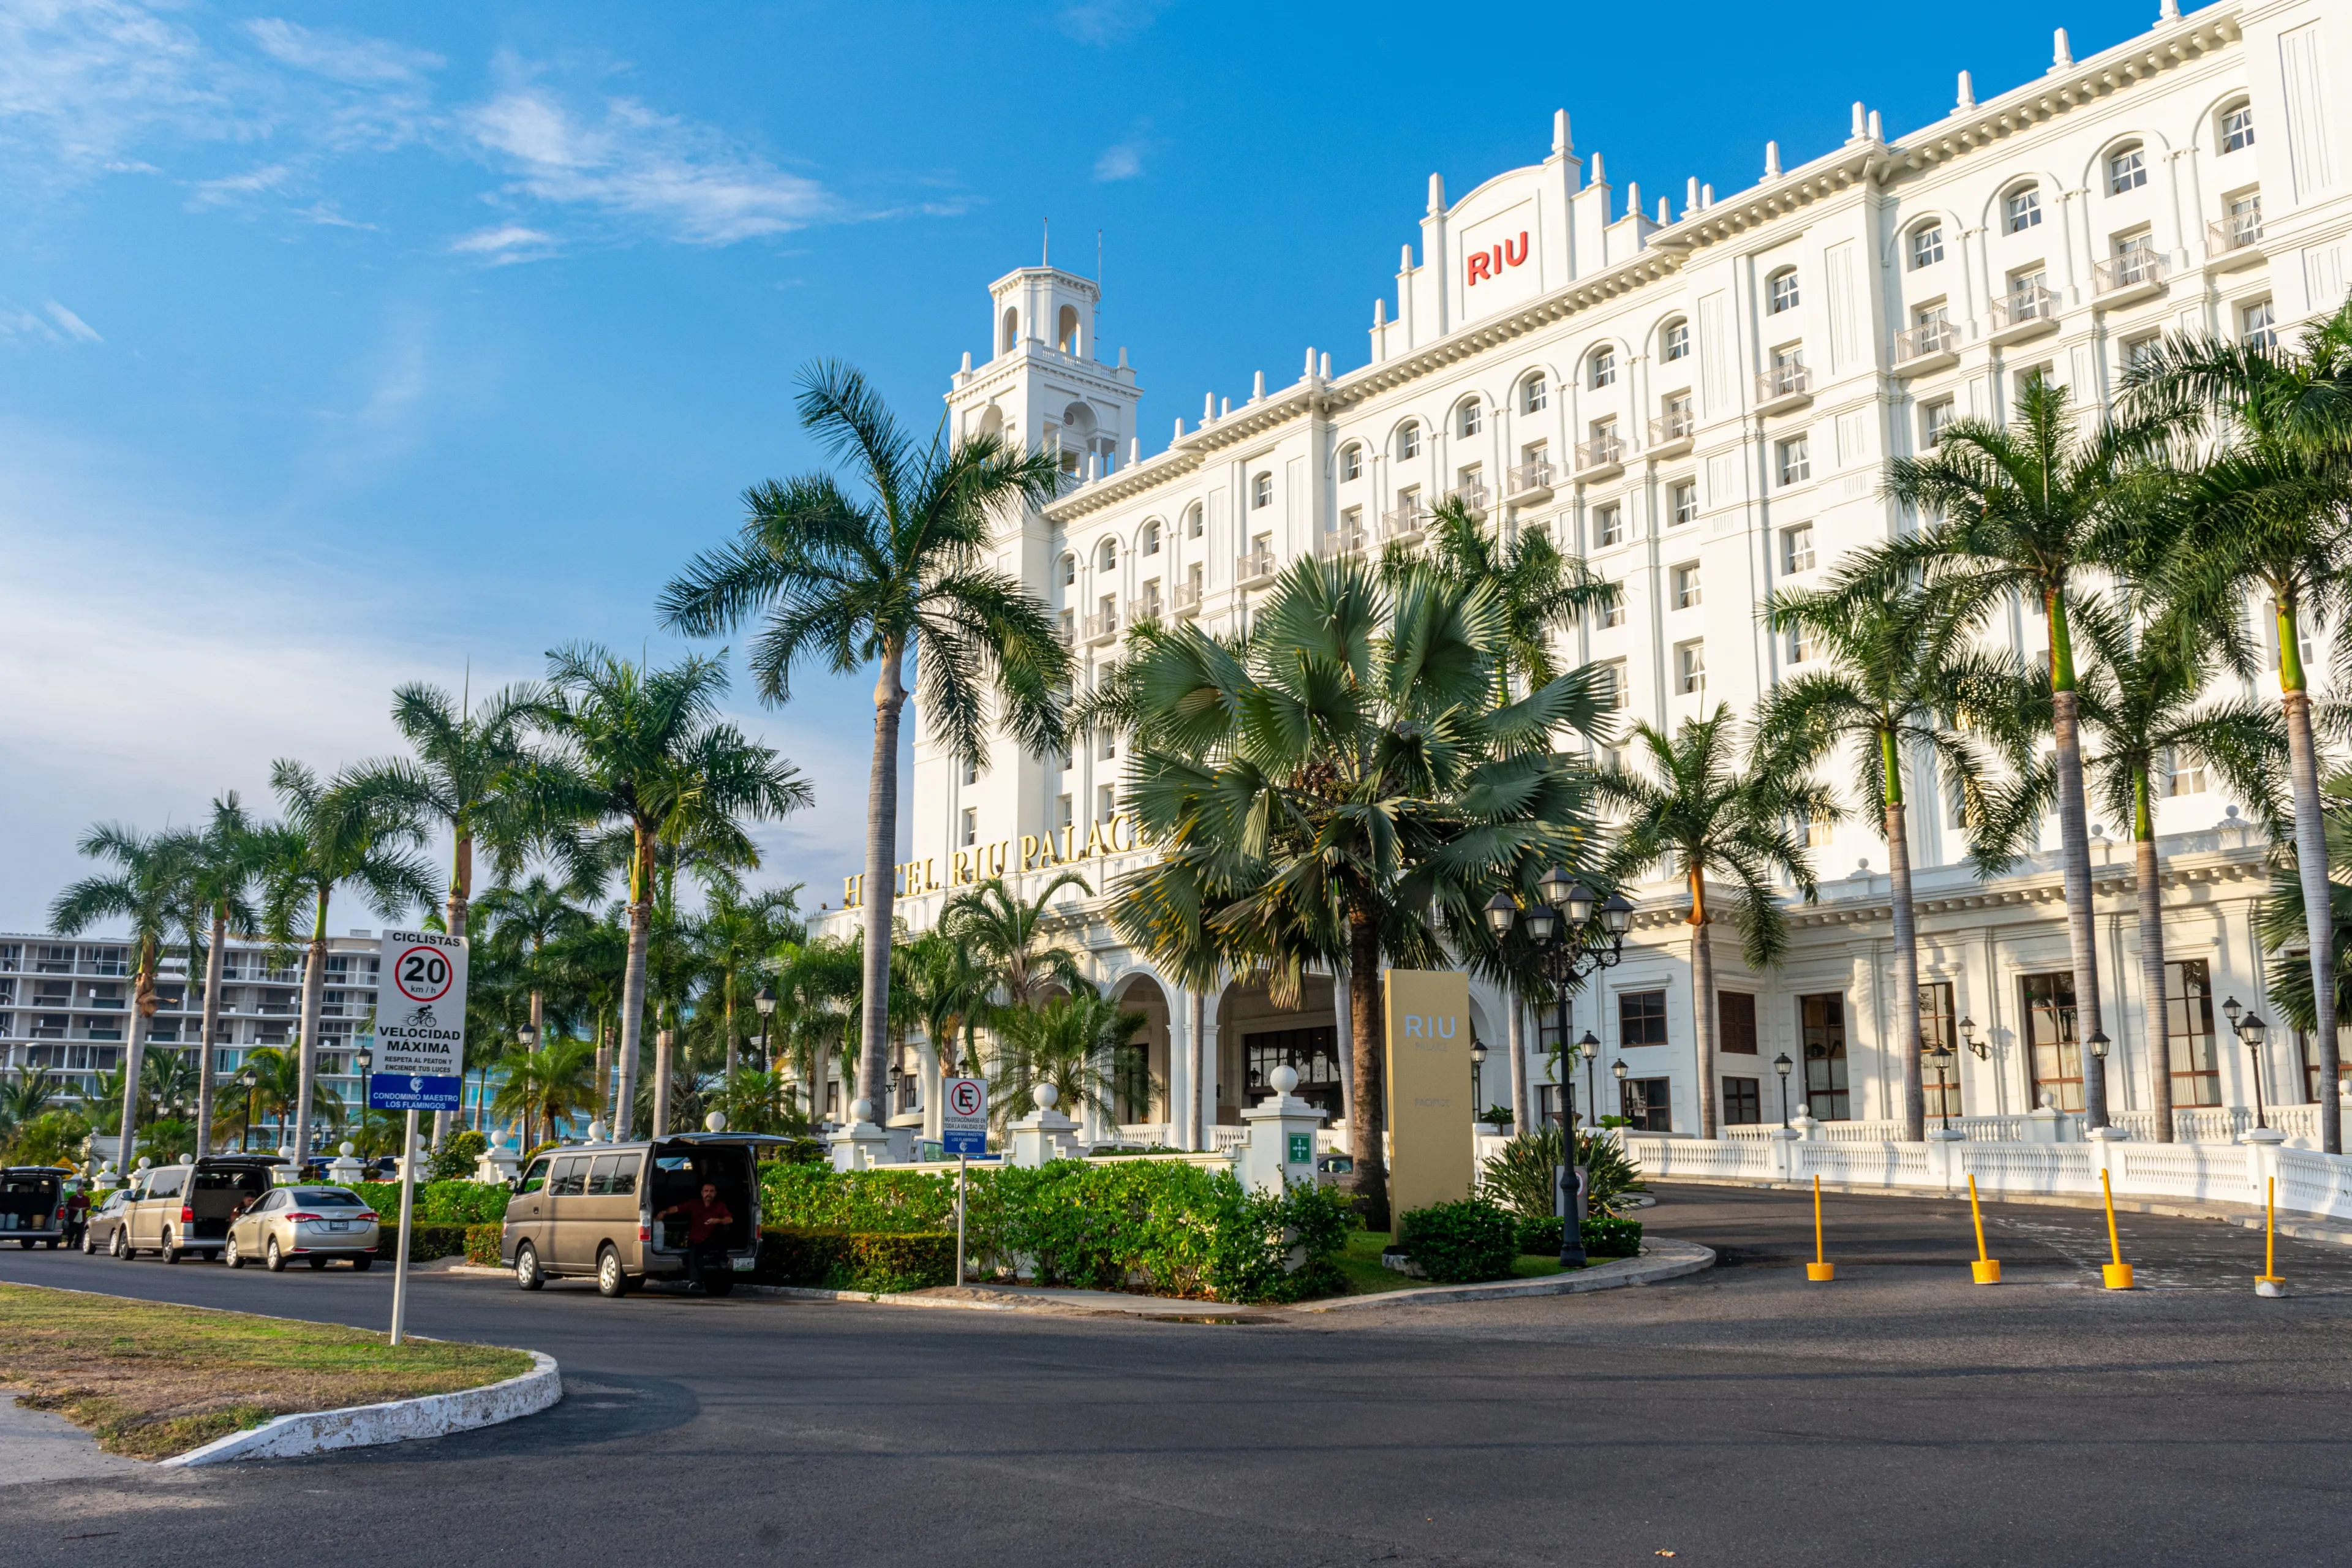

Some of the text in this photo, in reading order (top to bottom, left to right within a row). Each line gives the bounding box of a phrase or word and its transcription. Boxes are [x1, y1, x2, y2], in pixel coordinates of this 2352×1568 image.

[1468, 231, 1528, 286] RIU
[843, 858, 939, 910] HEL
[951, 840, 1008, 887] RIU
[393, 932, 460, 947] CICLISTAS
[404, 956, 445, 984] 20
[379, 1027, 460, 1040] VELOCIDAD
[1405, 1014, 1456, 1039] RIU
[387, 1039, 450, 1054] MÁXIMA
[373, 1092, 421, 1101] CONDOMINIO
[959, 1089, 973, 1107] E
